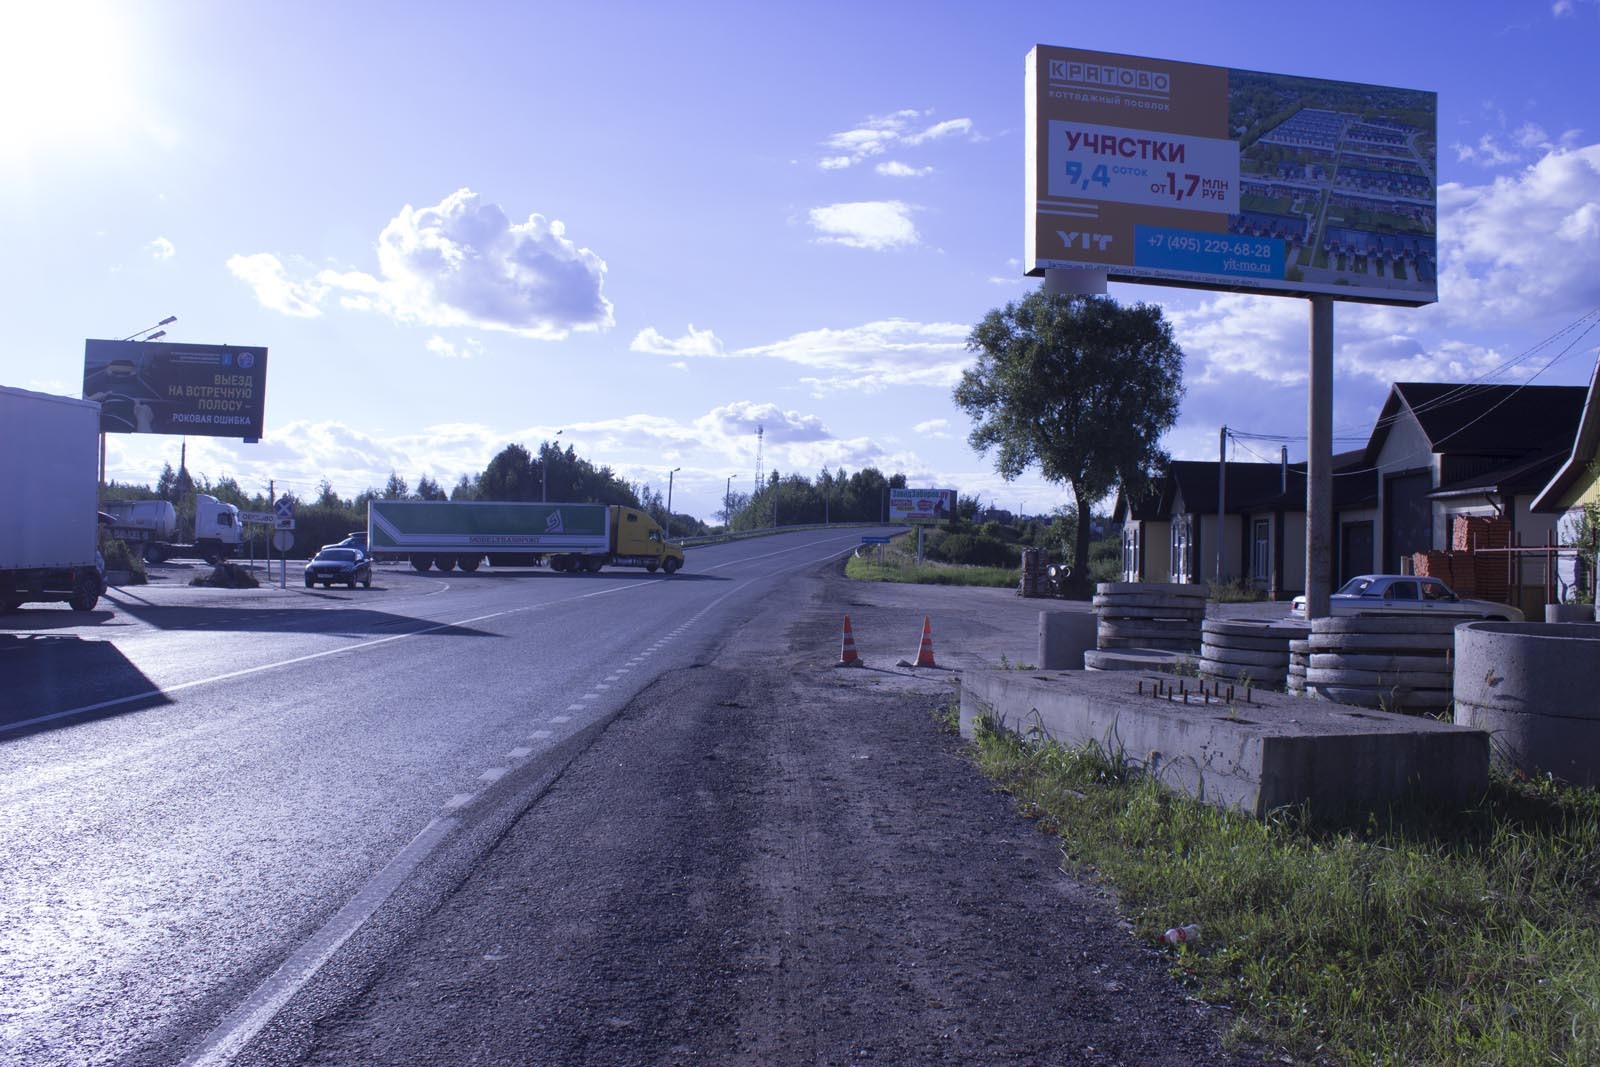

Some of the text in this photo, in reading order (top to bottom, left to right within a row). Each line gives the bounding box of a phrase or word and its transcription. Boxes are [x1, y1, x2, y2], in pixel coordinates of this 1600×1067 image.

[1050, 61, 1169, 91] КРАТОВО
[1065, 131, 1185, 164] УЧАСТКИ
[1065, 161, 1111, 191] 9,4
[1167, 172, 1200, 201] 1,7
[1202, 179, 1228, 190] МЛН
[1202, 189, 1225, 200] РУБ
[1056, 230, 1113, 251] YIT
[1148, 235, 1271, 258] +7 (495) 229-68-28
[1223, 259, 1271, 273] yit-mo.ru
[214, 374, 253, 387] ВЫЕЗД
[168, 385, 252, 399] НА ВСТРЕЧНУЮ
[199, 399, 243, 411] ПОЛОСУ
[172, 413, 251, 425] РОКОВАЯ ОШИБКА
